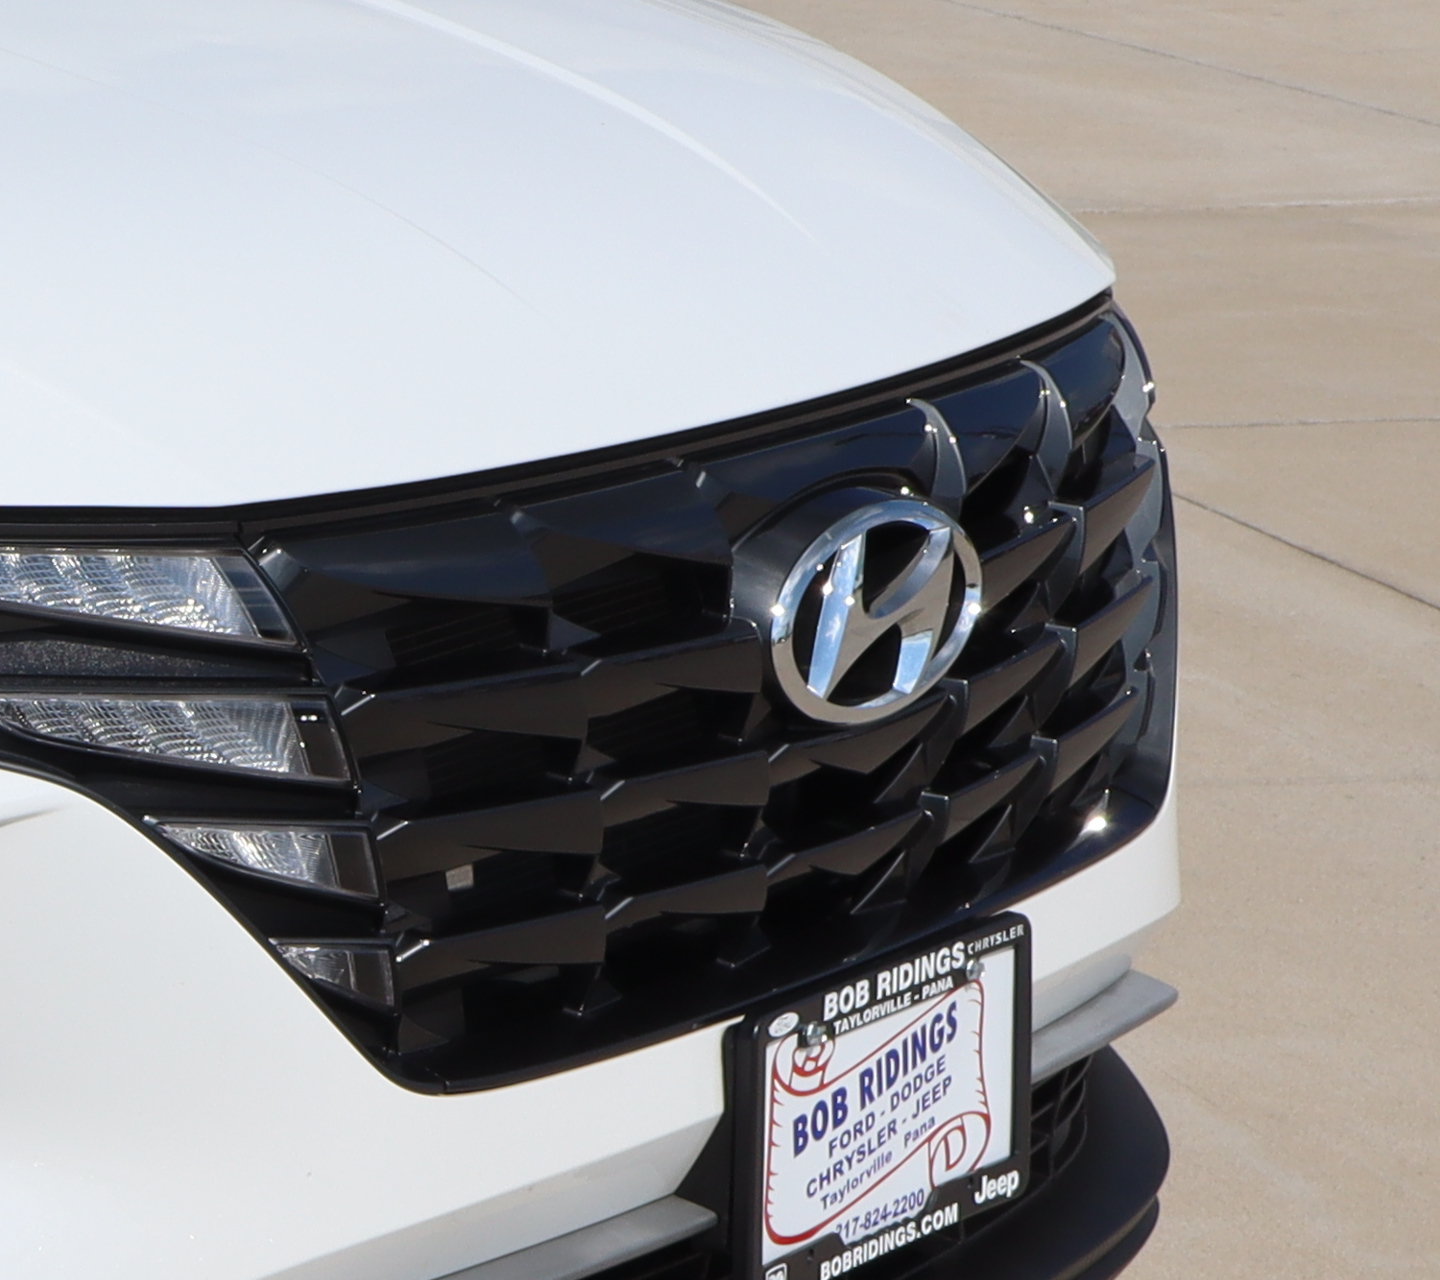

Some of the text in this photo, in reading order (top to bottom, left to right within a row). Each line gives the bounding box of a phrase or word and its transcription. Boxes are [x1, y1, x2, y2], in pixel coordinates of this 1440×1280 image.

[823, 941, 966, 1022] BOB RIDINGS
[967, 924, 1025, 955] CHRYSLER
[833, 991, 912, 1036] TAYLORVILLE
[921, 975, 954, 1000] PANA
[793, 1000, 958, 1158] BOB RIDINGS
[828, 1111, 876, 1159] FORD
[890, 1053, 946, 1113] DODGE
[806, 1118, 897, 1198] CHRYSLER
[911, 1075, 952, 1120] JEEP
[820, 1116, 936, 1210] Taylorville Pana
[974, 1169, 1020, 1205] Jeep
